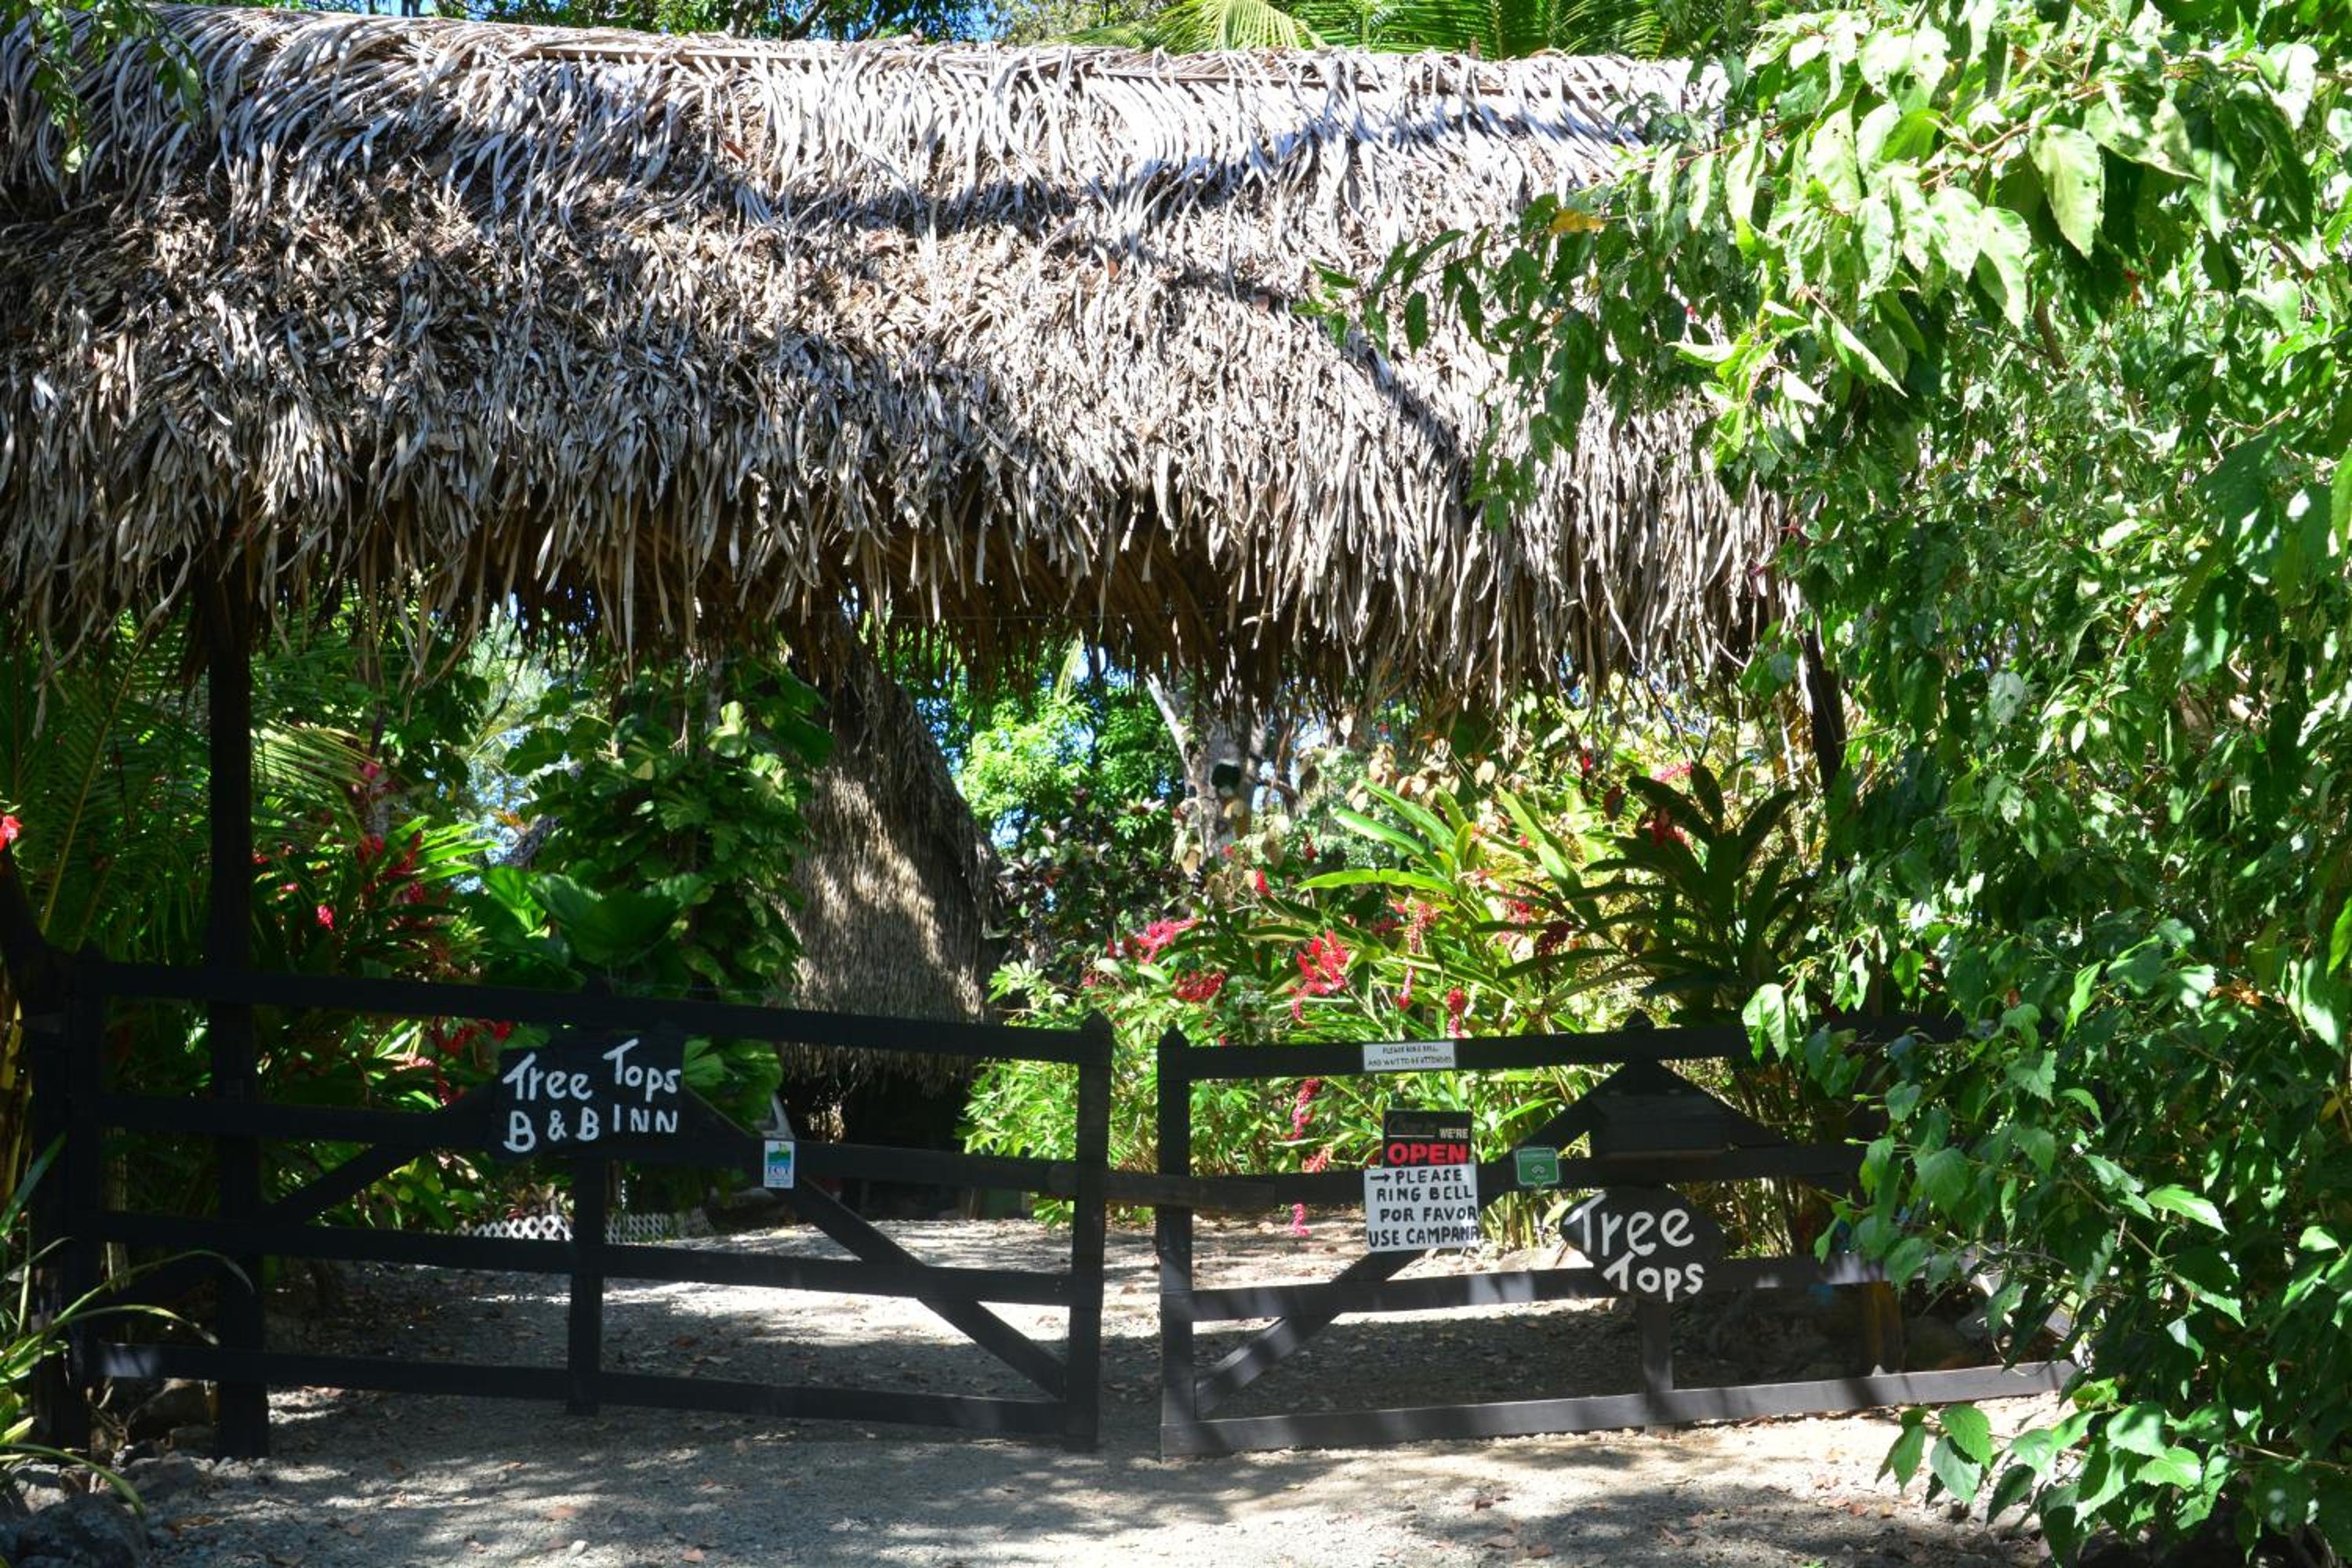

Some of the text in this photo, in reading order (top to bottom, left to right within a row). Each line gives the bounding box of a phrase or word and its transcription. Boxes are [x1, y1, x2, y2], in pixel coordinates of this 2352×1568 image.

[502, 1037, 681, 1102] Tree Tops
[612, 1104, 678, 1134] INN
[1439, 1128, 1468, 1139] WE'RE
[1387, 1142, 1468, 1165] OPEN
[1396, 1169, 1462, 1184] PLEASE
[1376, 1185, 1475, 1202] RING BELL
[1380, 1205, 1478, 1223] POR FAVOR
[1563, 1192, 1694, 1257] Tree
[1368, 1225, 1480, 1247] USE CAMPANA
[1602, 1250, 1704, 1303] Tops
